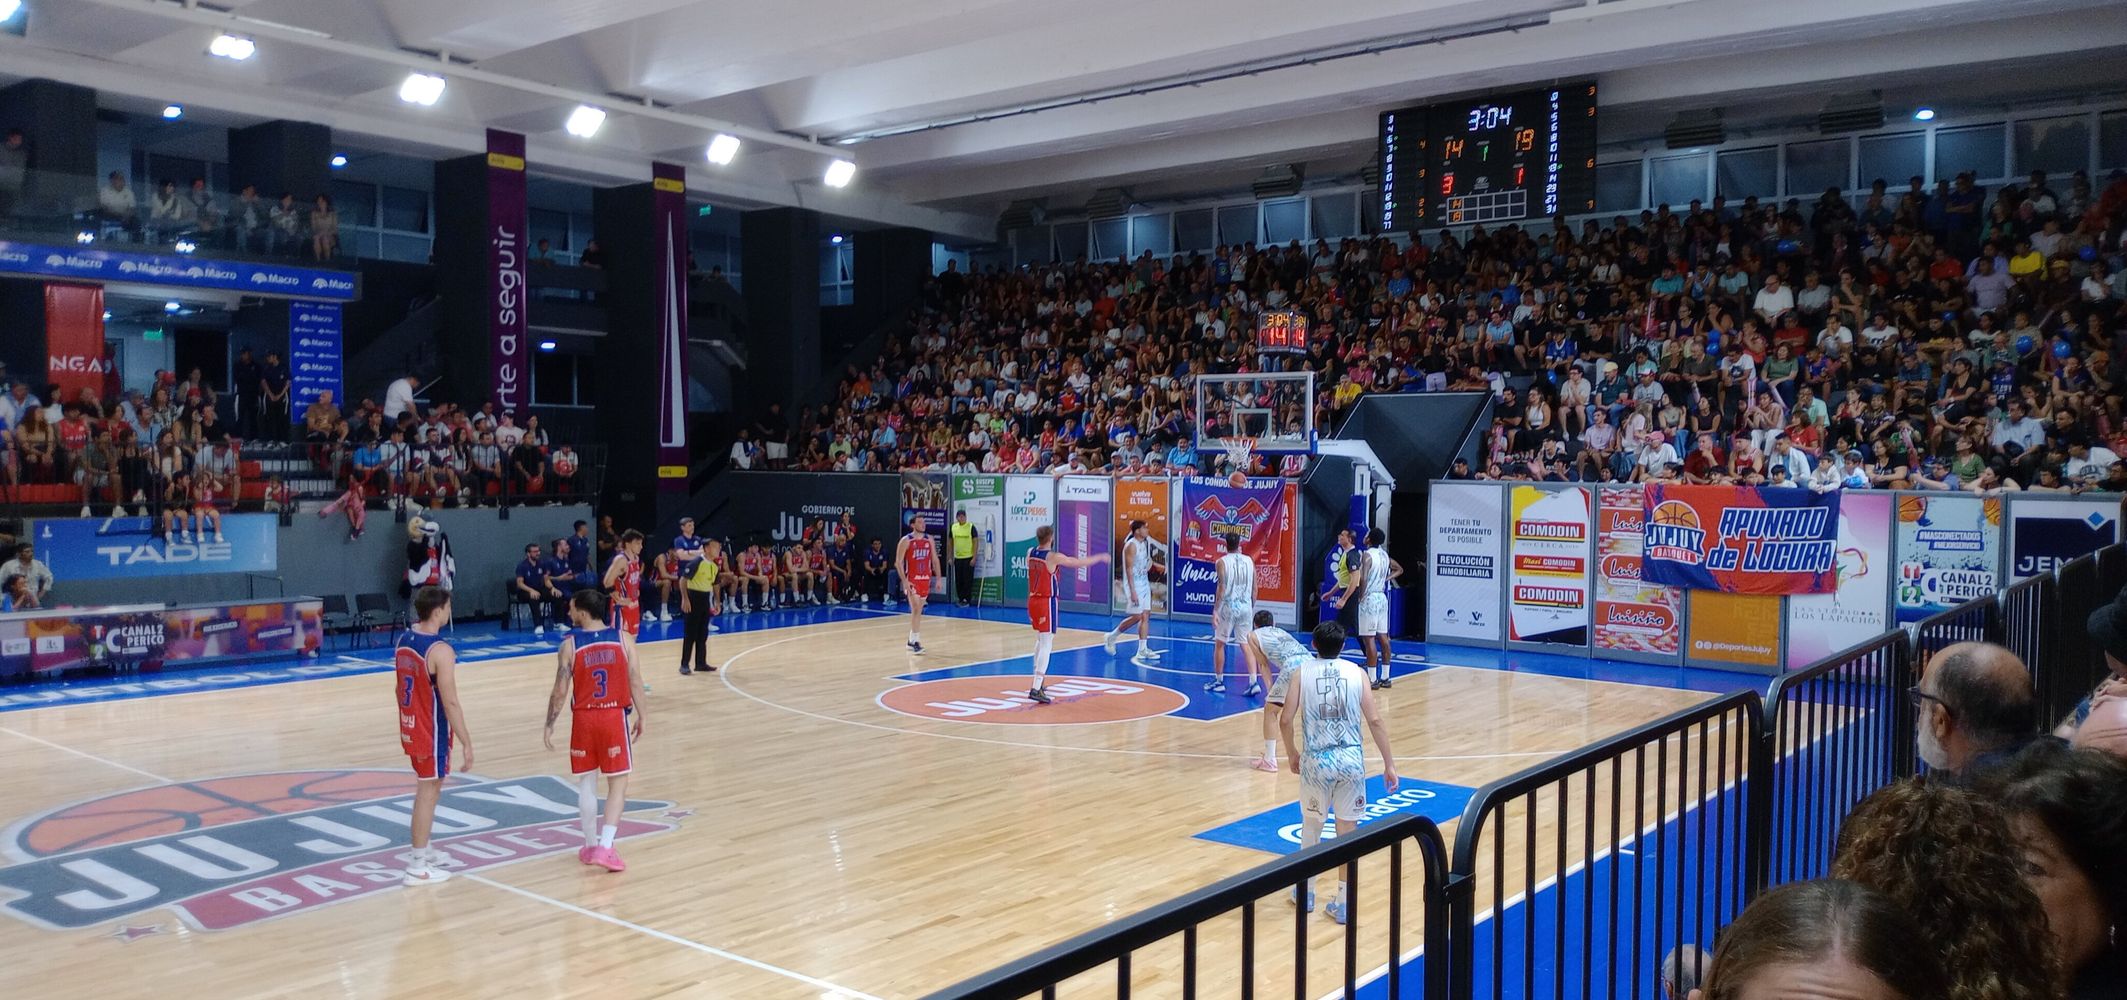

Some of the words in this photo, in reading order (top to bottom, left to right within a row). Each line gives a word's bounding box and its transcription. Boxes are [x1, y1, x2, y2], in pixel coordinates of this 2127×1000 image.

[1469, 106, 1512, 131] 3:04
[1515, 128, 1535, 151] 19
[1444, 139, 1464, 160] 14
[1442, 175, 1455, 194] 3
[66, 256, 103, 269] Macro
[204, 268, 237, 281] Macro
[268, 273, 300, 286] Macro
[493, 225, 522, 326] seguir
[499, 334, 517, 356] a
[1190, 476, 1203, 486] LOS
[1243, 480, 1253, 489] DE
[1254, 480, 1279, 490] JUJUY
[801, 504, 843, 515] GOBIERNO
[844, 506, 855, 516] DE
[1211, 522, 1251, 537] CONDORES
[1472, 519, 1481, 527] TU
[1519, 523, 1580, 538] COMODIN
[1719, 507, 1829, 540] APUNADO
[1439, 526, 1492, 536] DEPARTAMENTO
[1647, 526, 1700, 551] JUJUY
[1447, 535, 1456, 543] ES
[1457, 536, 1483, 544] POSIBLE
[97, 543, 232, 566] TADE
[1440, 555, 1490, 567] REVOLUCIÓN
[1706, 538, 1740, 570] de
[1742, 541, 1836, 573] LOCURA
[1542, 557, 1576, 568] COMODIN
[1439, 567, 1491, 578] INMOBILIARIA
[1941, 571, 1983, 585] CANAL
[1984, 574, 1993, 586] 2
[1519, 587, 1579, 603] COMODIN
[1946, 584, 1993, 597] PERICO
[1608, 604, 1665, 625] Luisiño
[1794, 611, 1816, 620] LOS
[1821, 613, 1882, 625] LAPACHOS
[121, 624, 157, 637] CANAL
[156, 624, 164, 635] 2
[126, 633, 165, 647] PERICO
[591, 668, 608, 699] 3
[1316, 677, 1348, 721] 31
[54, 784, 581, 910] JUJUY
